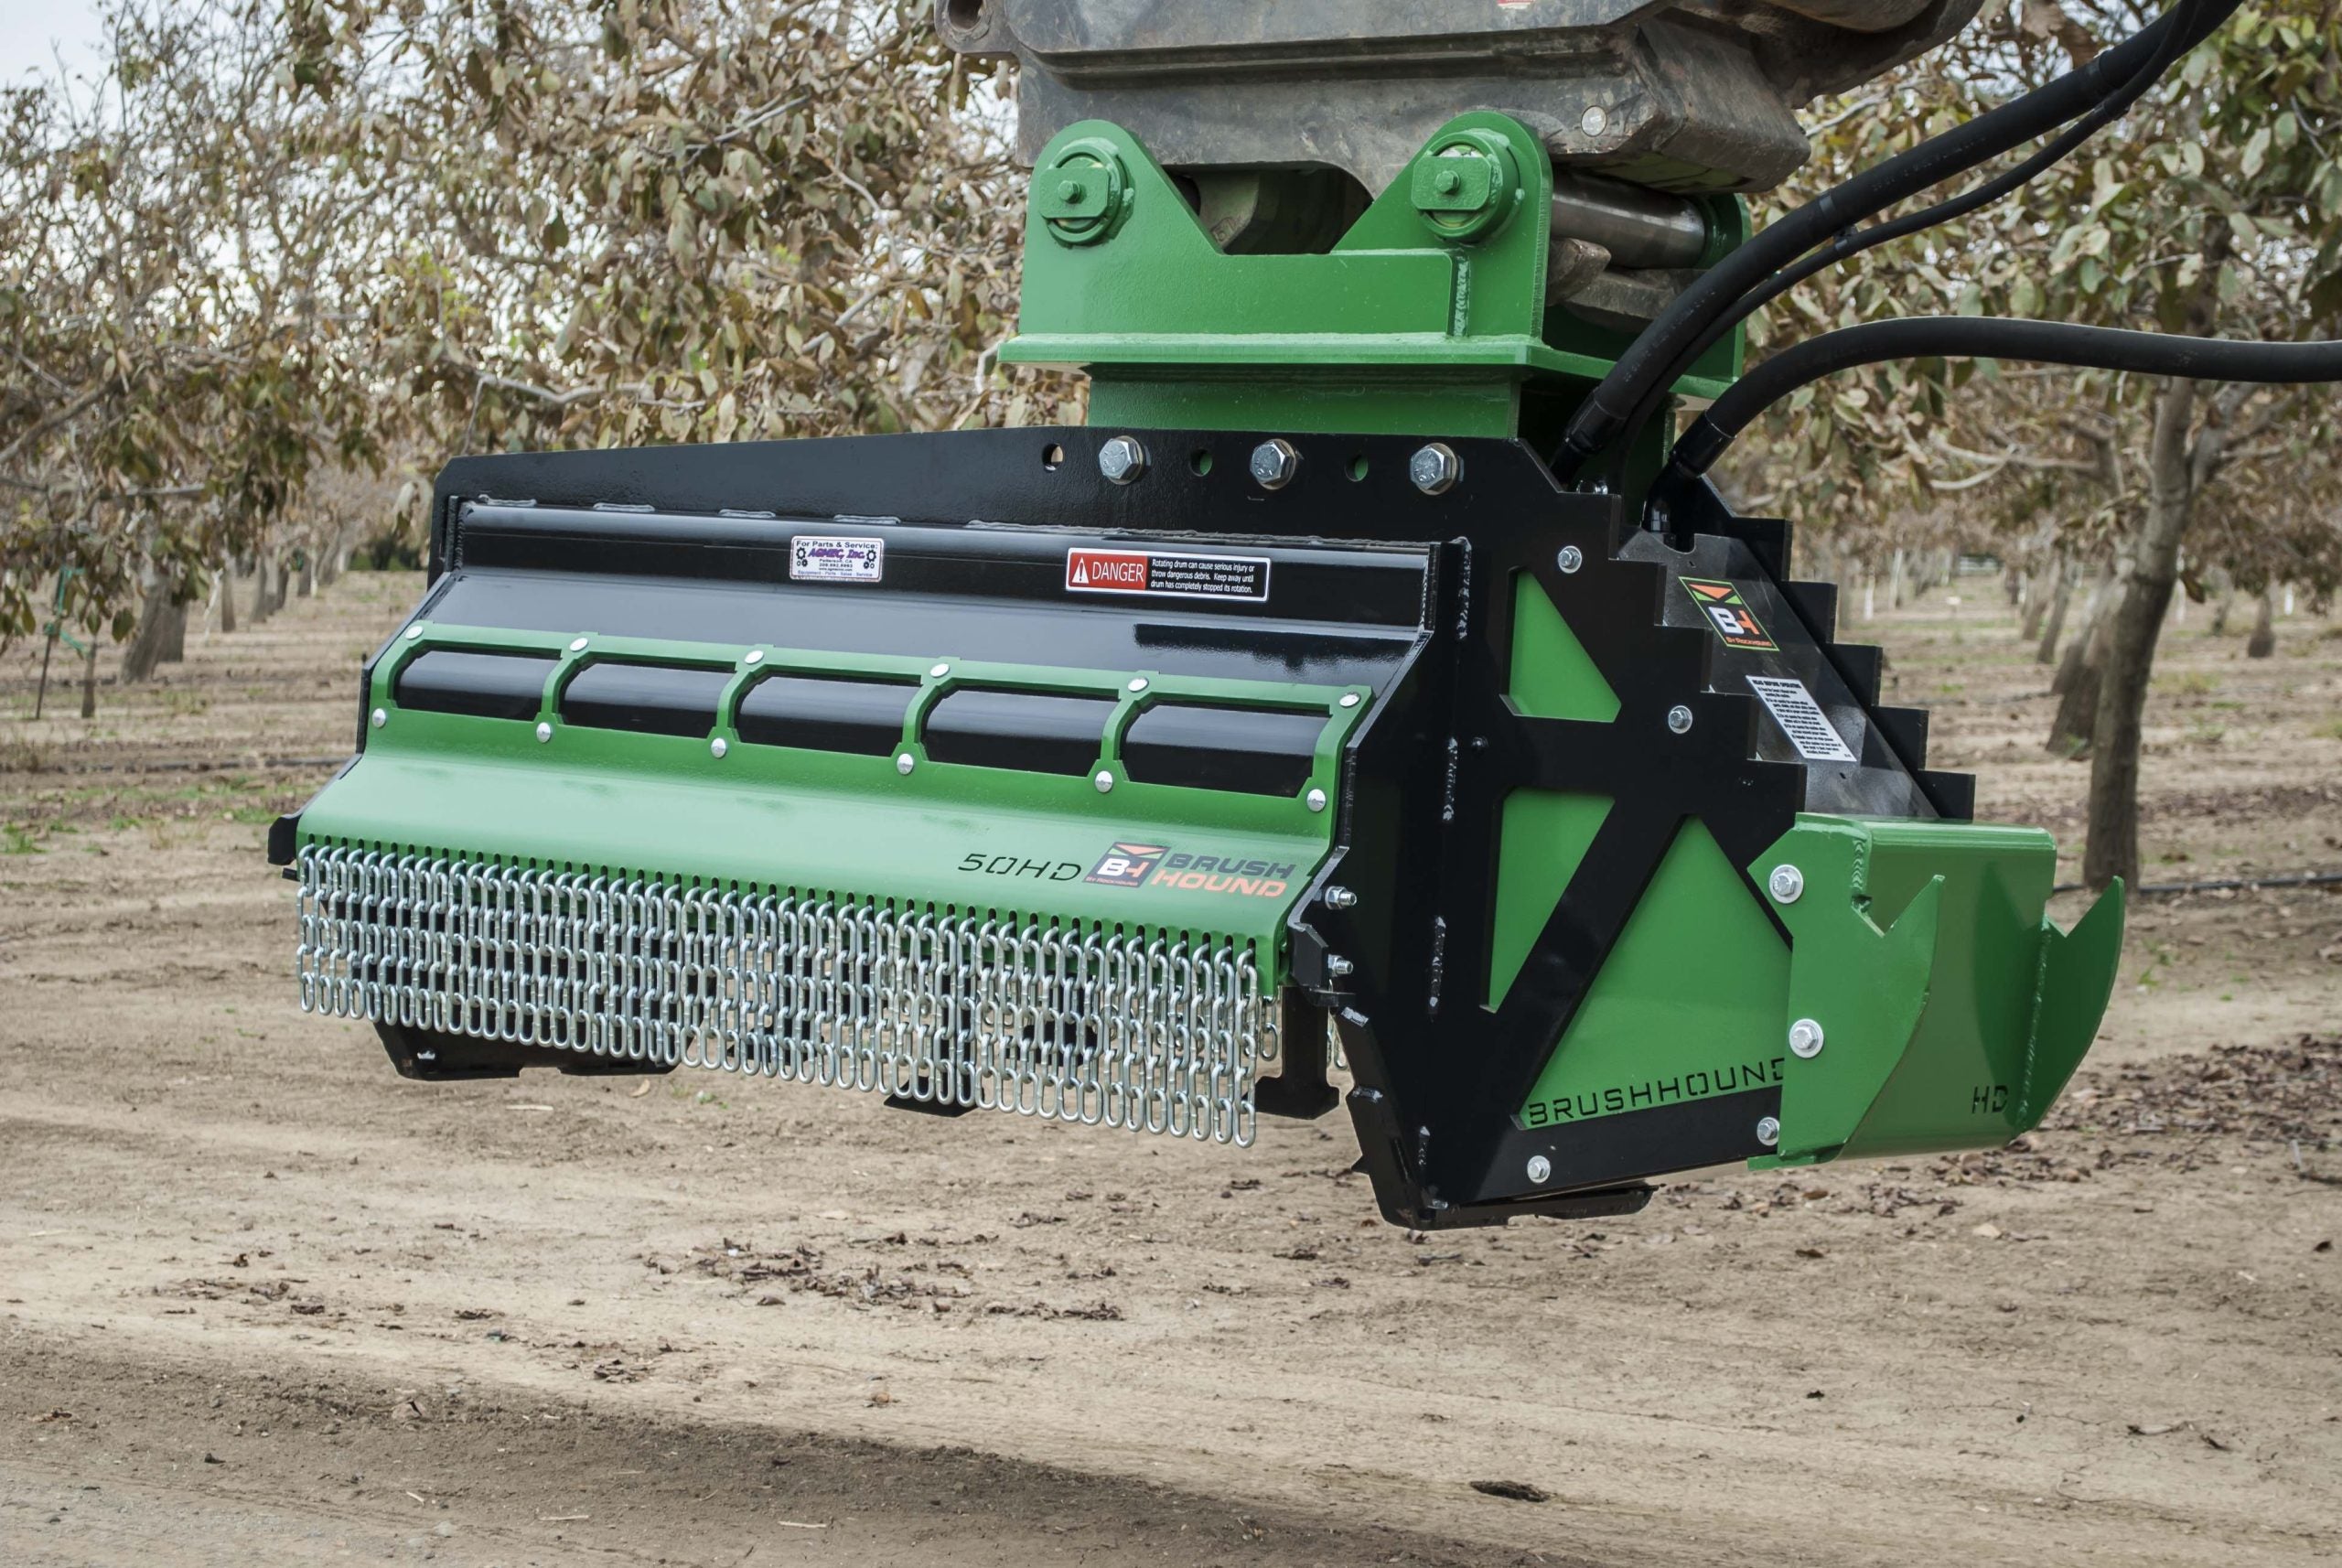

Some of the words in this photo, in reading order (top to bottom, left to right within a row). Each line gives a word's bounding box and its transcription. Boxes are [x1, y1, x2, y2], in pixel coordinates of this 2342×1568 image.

[844, 542, 878, 550] Service:
[1091, 561, 1144, 583] DANGER
[1152, 559, 1173, 569] Rotating
[1174, 560, 1187, 568] drum
[1214, 563, 1232, 571] serious
[1233, 564, 1248, 574] injury
[1152, 569, 1166, 577] throw
[1166, 570, 1193, 580] dangerous
[1194, 572, 1210, 580] debris.
[1213, 573, 1227, 583] Keep
[1228, 575, 1241, 584] away
[1241, 575, 1254, 583] until
[1150, 579, 1165, 588] drum
[1165, 580, 1175, 589] has
[1175, 582, 1202, 592] completely
[1202, 584, 1223, 593] stopped
[1230, 585, 1252, 594] rotation.
[958, 854, 1081, 881] 50HD
[1165, 853, 1296, 879] BRUSH
[1150, 869, 1287, 897] HOUND
[1971, 1085, 2009, 1114] HD
